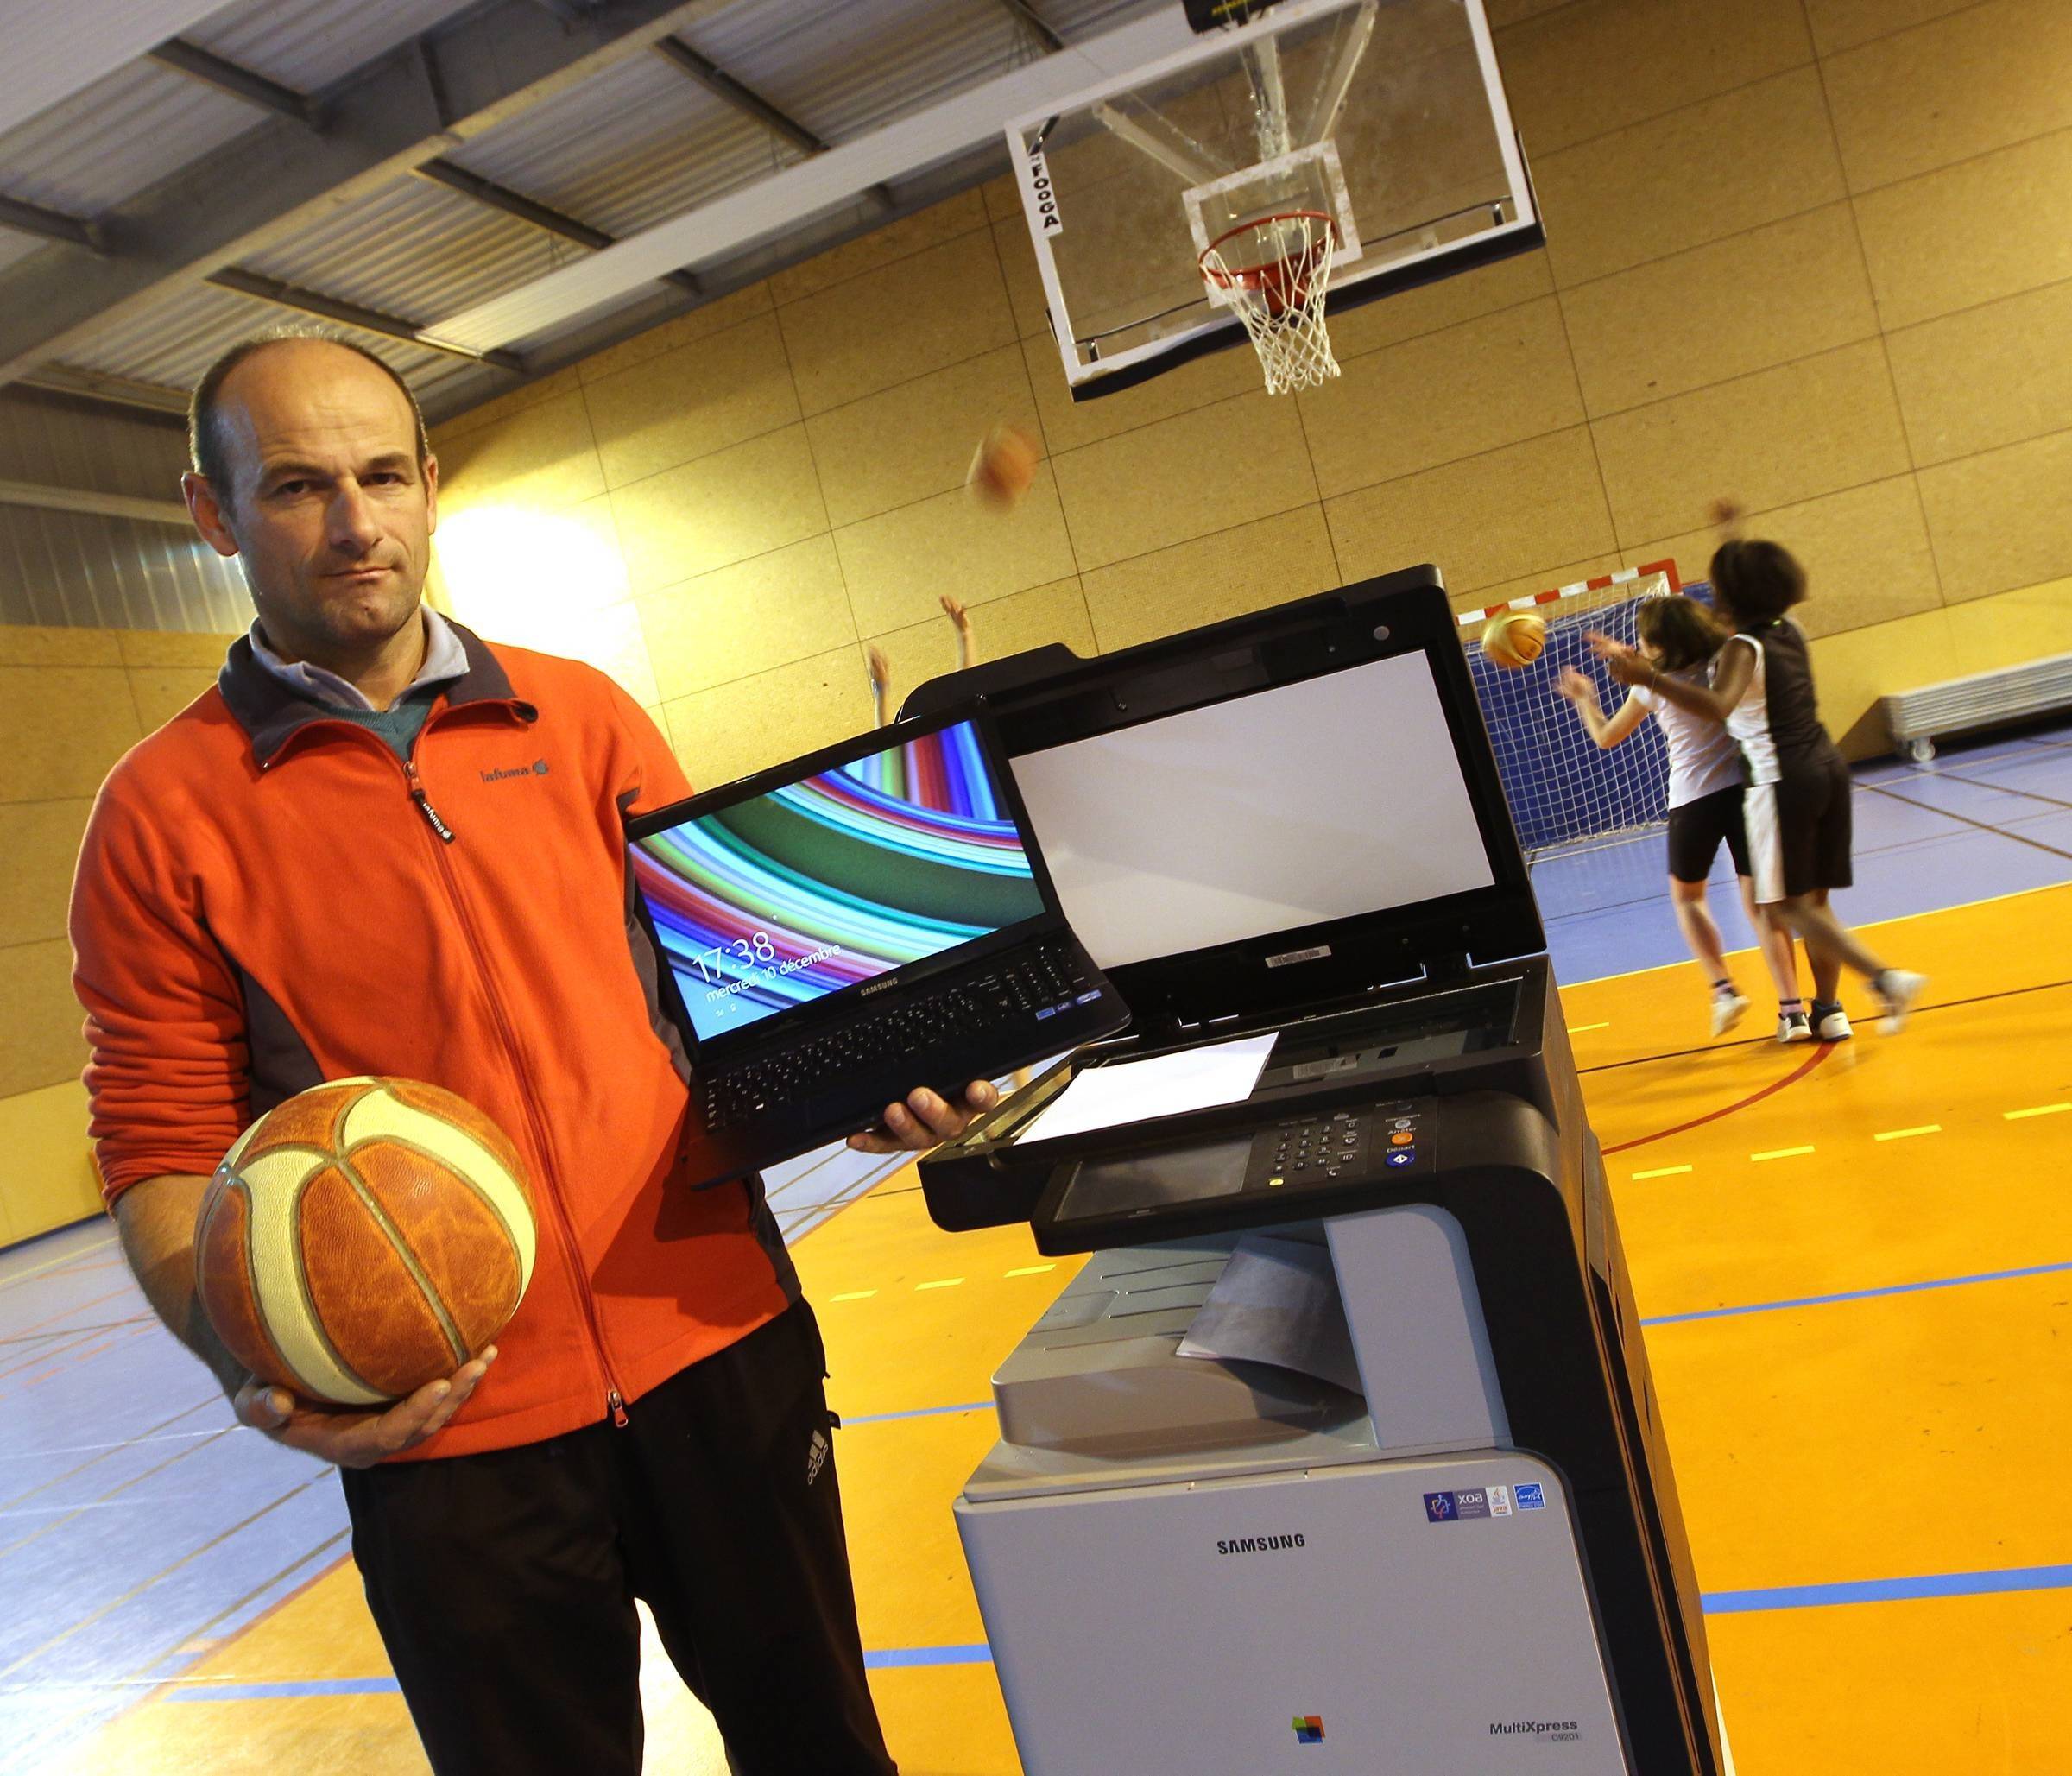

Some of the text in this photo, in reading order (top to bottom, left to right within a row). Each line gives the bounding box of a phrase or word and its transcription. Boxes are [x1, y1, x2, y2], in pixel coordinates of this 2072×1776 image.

[692, 931, 775, 983] 17:38
[704, 943, 843, 1003] mercredi 10 décembre
[860, 976, 899, 996] SAMSUNG
[1216, 1533, 1305, 1555] SAMSUNG
[1489, 1721, 1578, 1735] MultiXpress
